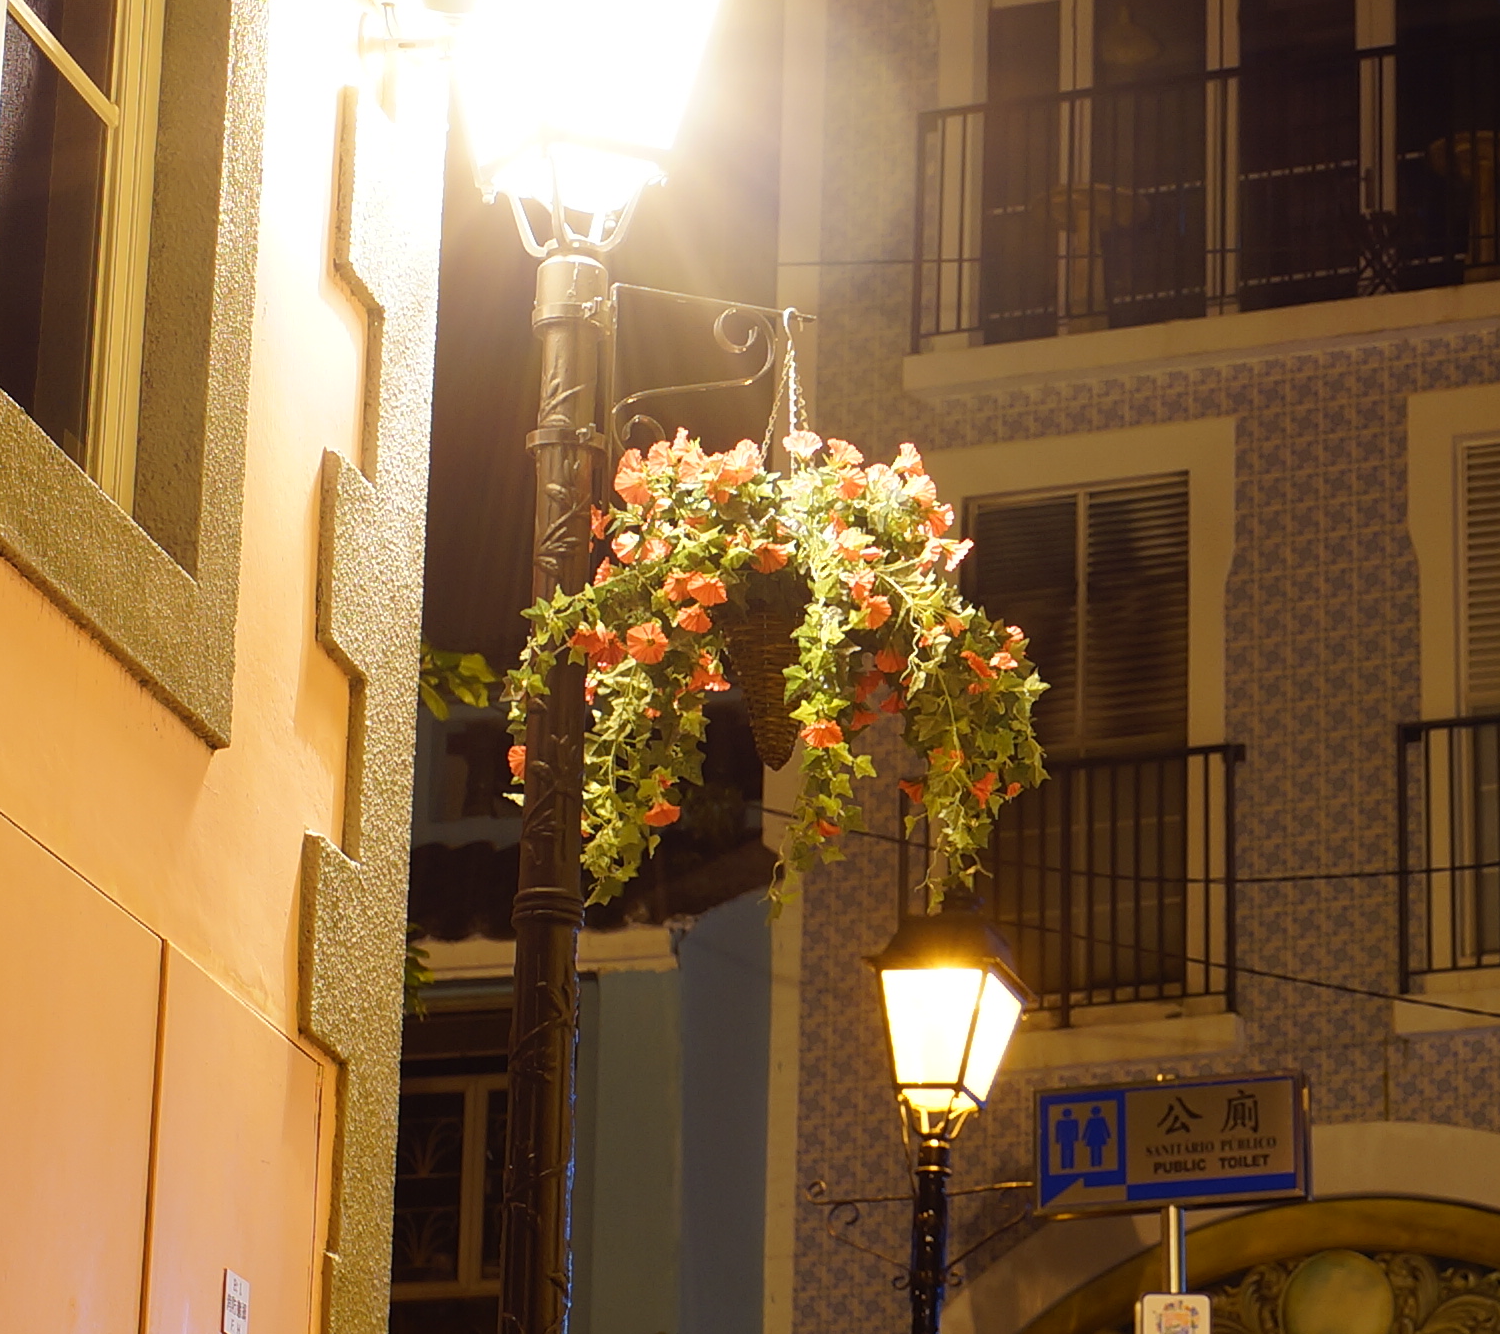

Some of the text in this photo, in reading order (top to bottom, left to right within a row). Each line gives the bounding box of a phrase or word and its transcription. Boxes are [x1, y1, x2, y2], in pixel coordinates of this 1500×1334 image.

[1155, 1089, 1260, 1135] 公廁
[1146, 1136, 1277, 1157] SANITÁRIO PÚBLICO
[1153, 1153, 1271, 1174] PUBLIC TOILET
